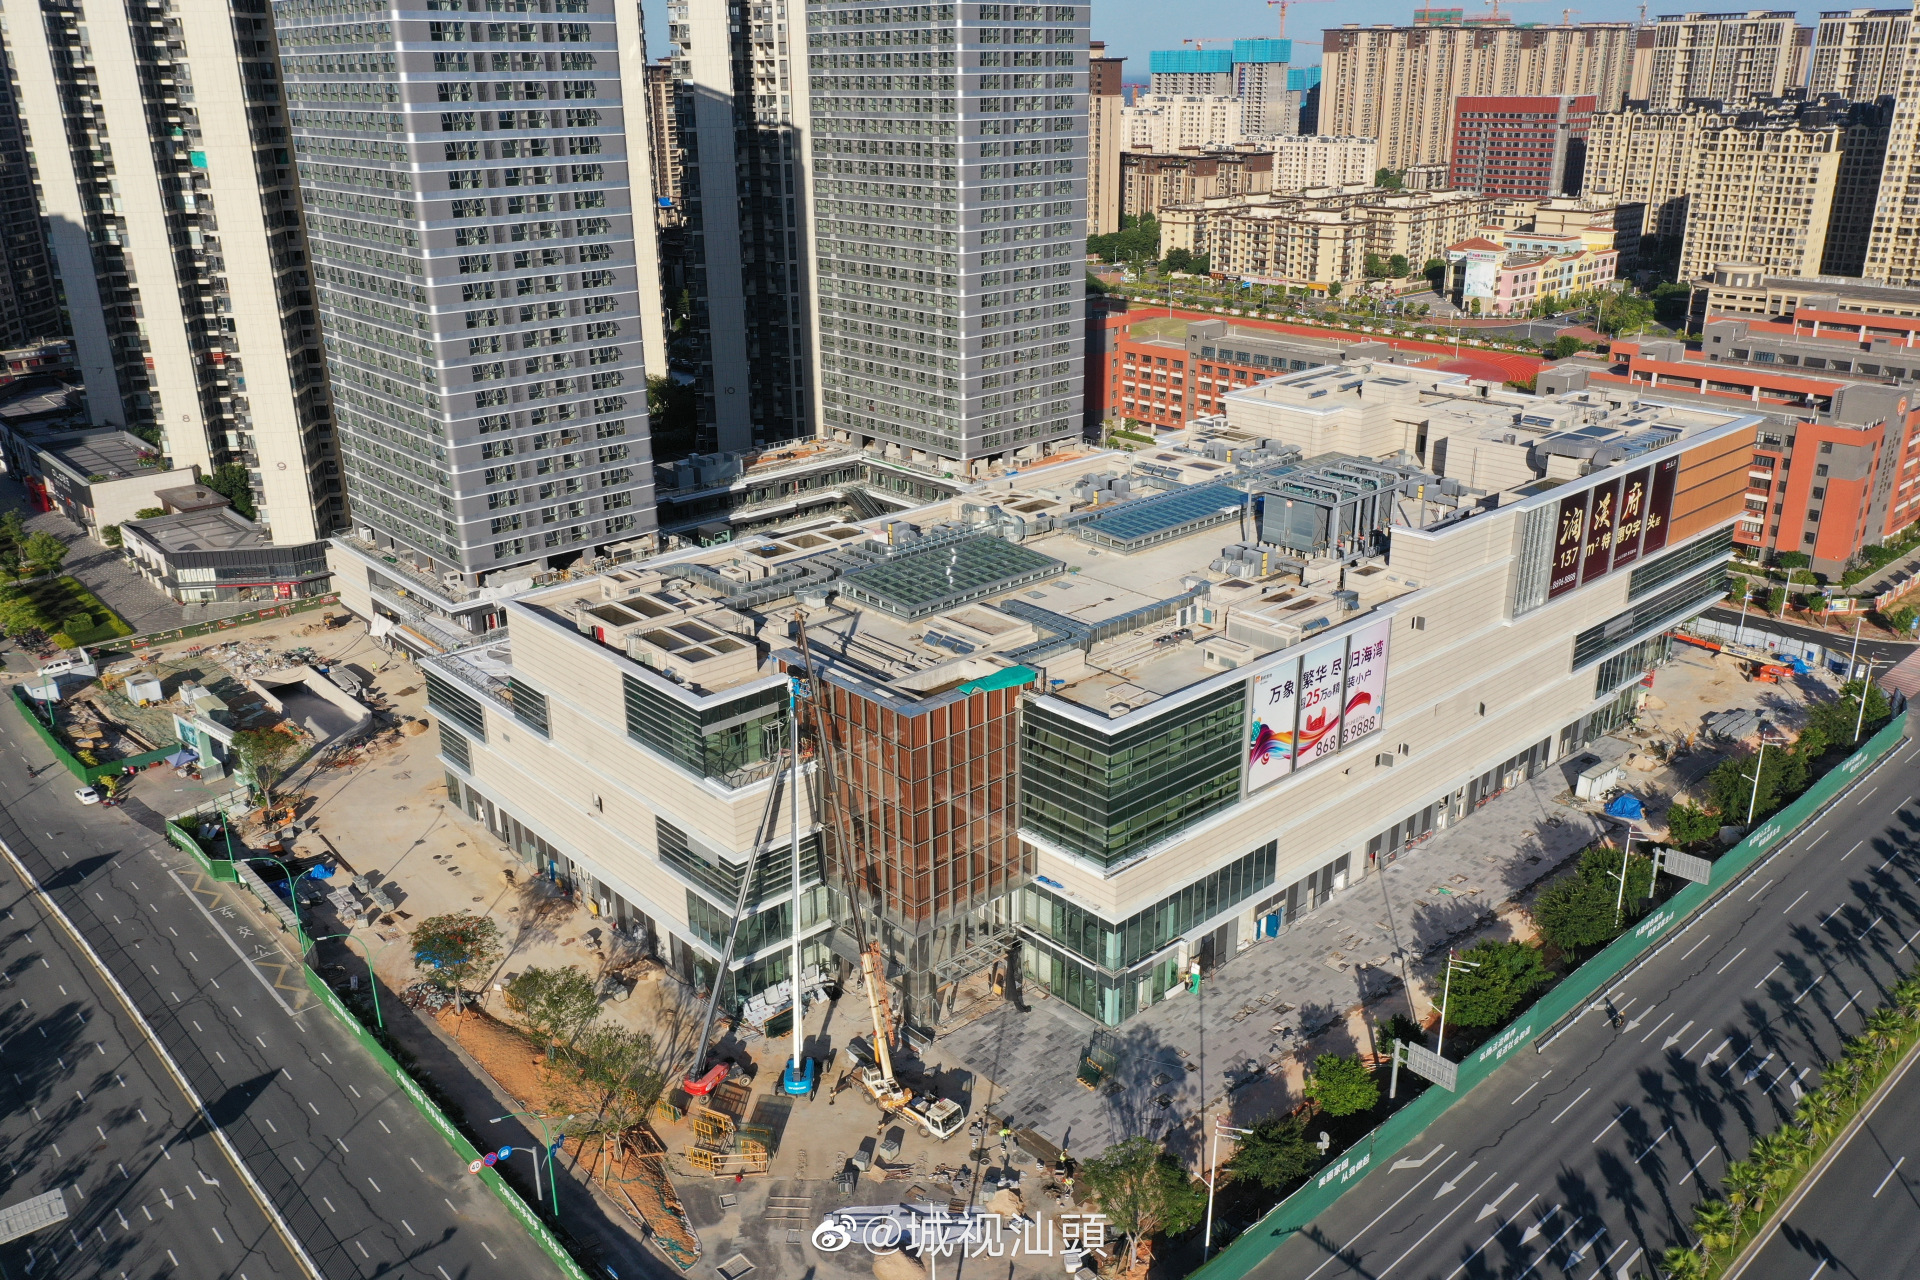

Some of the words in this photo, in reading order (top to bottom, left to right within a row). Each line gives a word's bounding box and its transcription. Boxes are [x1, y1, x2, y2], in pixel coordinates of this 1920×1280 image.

[183, 414, 190, 422] 8
[277, 462, 286, 470] 9
[471, 1162, 480, 1170] 40
